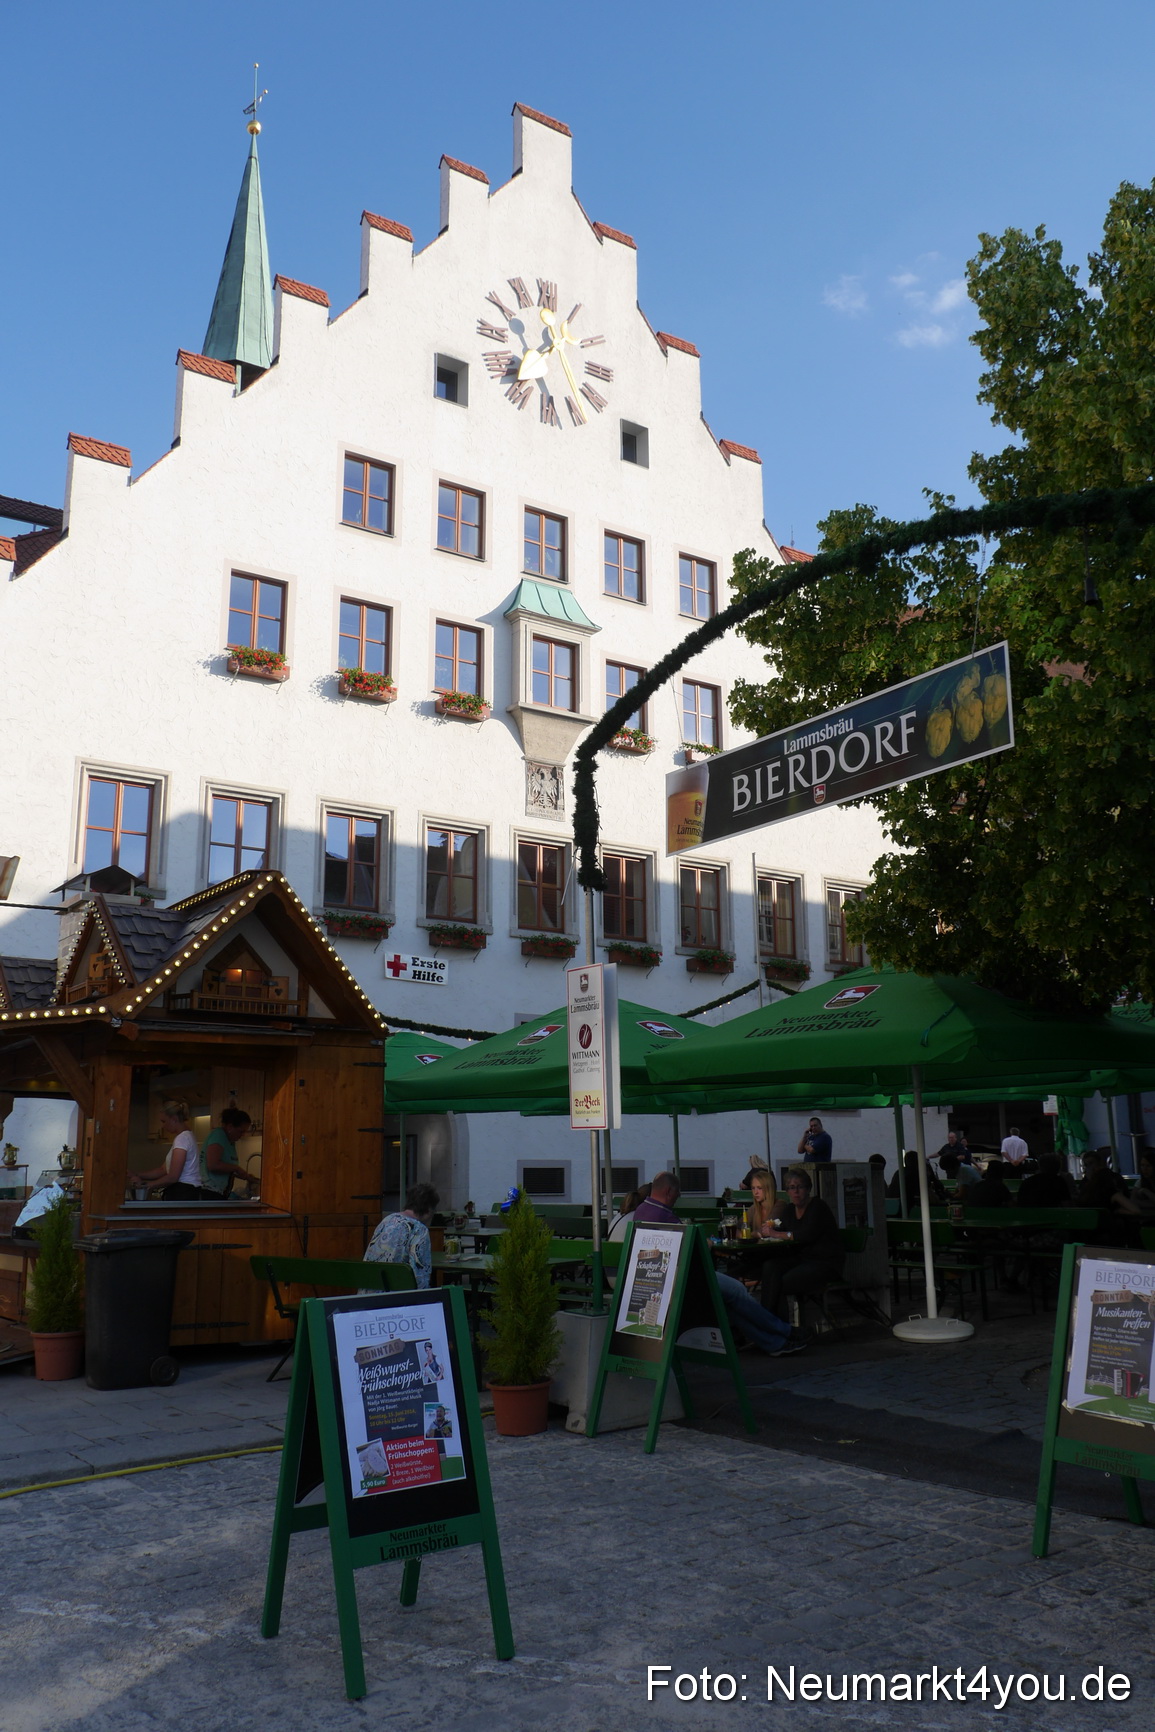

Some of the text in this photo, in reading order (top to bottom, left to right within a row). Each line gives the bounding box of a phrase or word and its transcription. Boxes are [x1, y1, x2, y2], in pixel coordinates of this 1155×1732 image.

[783, 717, 855, 755] Lammsbräu
[732, 710, 917, 813] BIERDORF
[411, 957, 446, 970] Erste
[412, 970, 444, 983] Hilfe
[571, 1002, 600, 1014] Lammsbräu
[777, 1009, 878, 1026] Neumarkter
[744, 1018, 882, 1040] Lammsbräu
[572, 1050, 600, 1060] WITTMANN
[453, 1056, 543, 1070] Lammsbräu
[1094, 1292, 1130, 1302] SONNTAG
[1096, 1306, 1146, 1318] Musikanten-
[354, 1317, 426, 1338] BIERDORF
[1123, 1318, 1151, 1330] treffen
[358, 1341, 401, 1360] SONNTAG
[386, 1440, 424, 1452] Aktion beim
[388, 1448, 435, 1460] Frühschoppen:
[1075, 1452, 1142, 1477] Lammsbräu
[390, 1522, 447, 1542] Neumarkter
[380, 1533, 459, 1561] Lammsbräu
